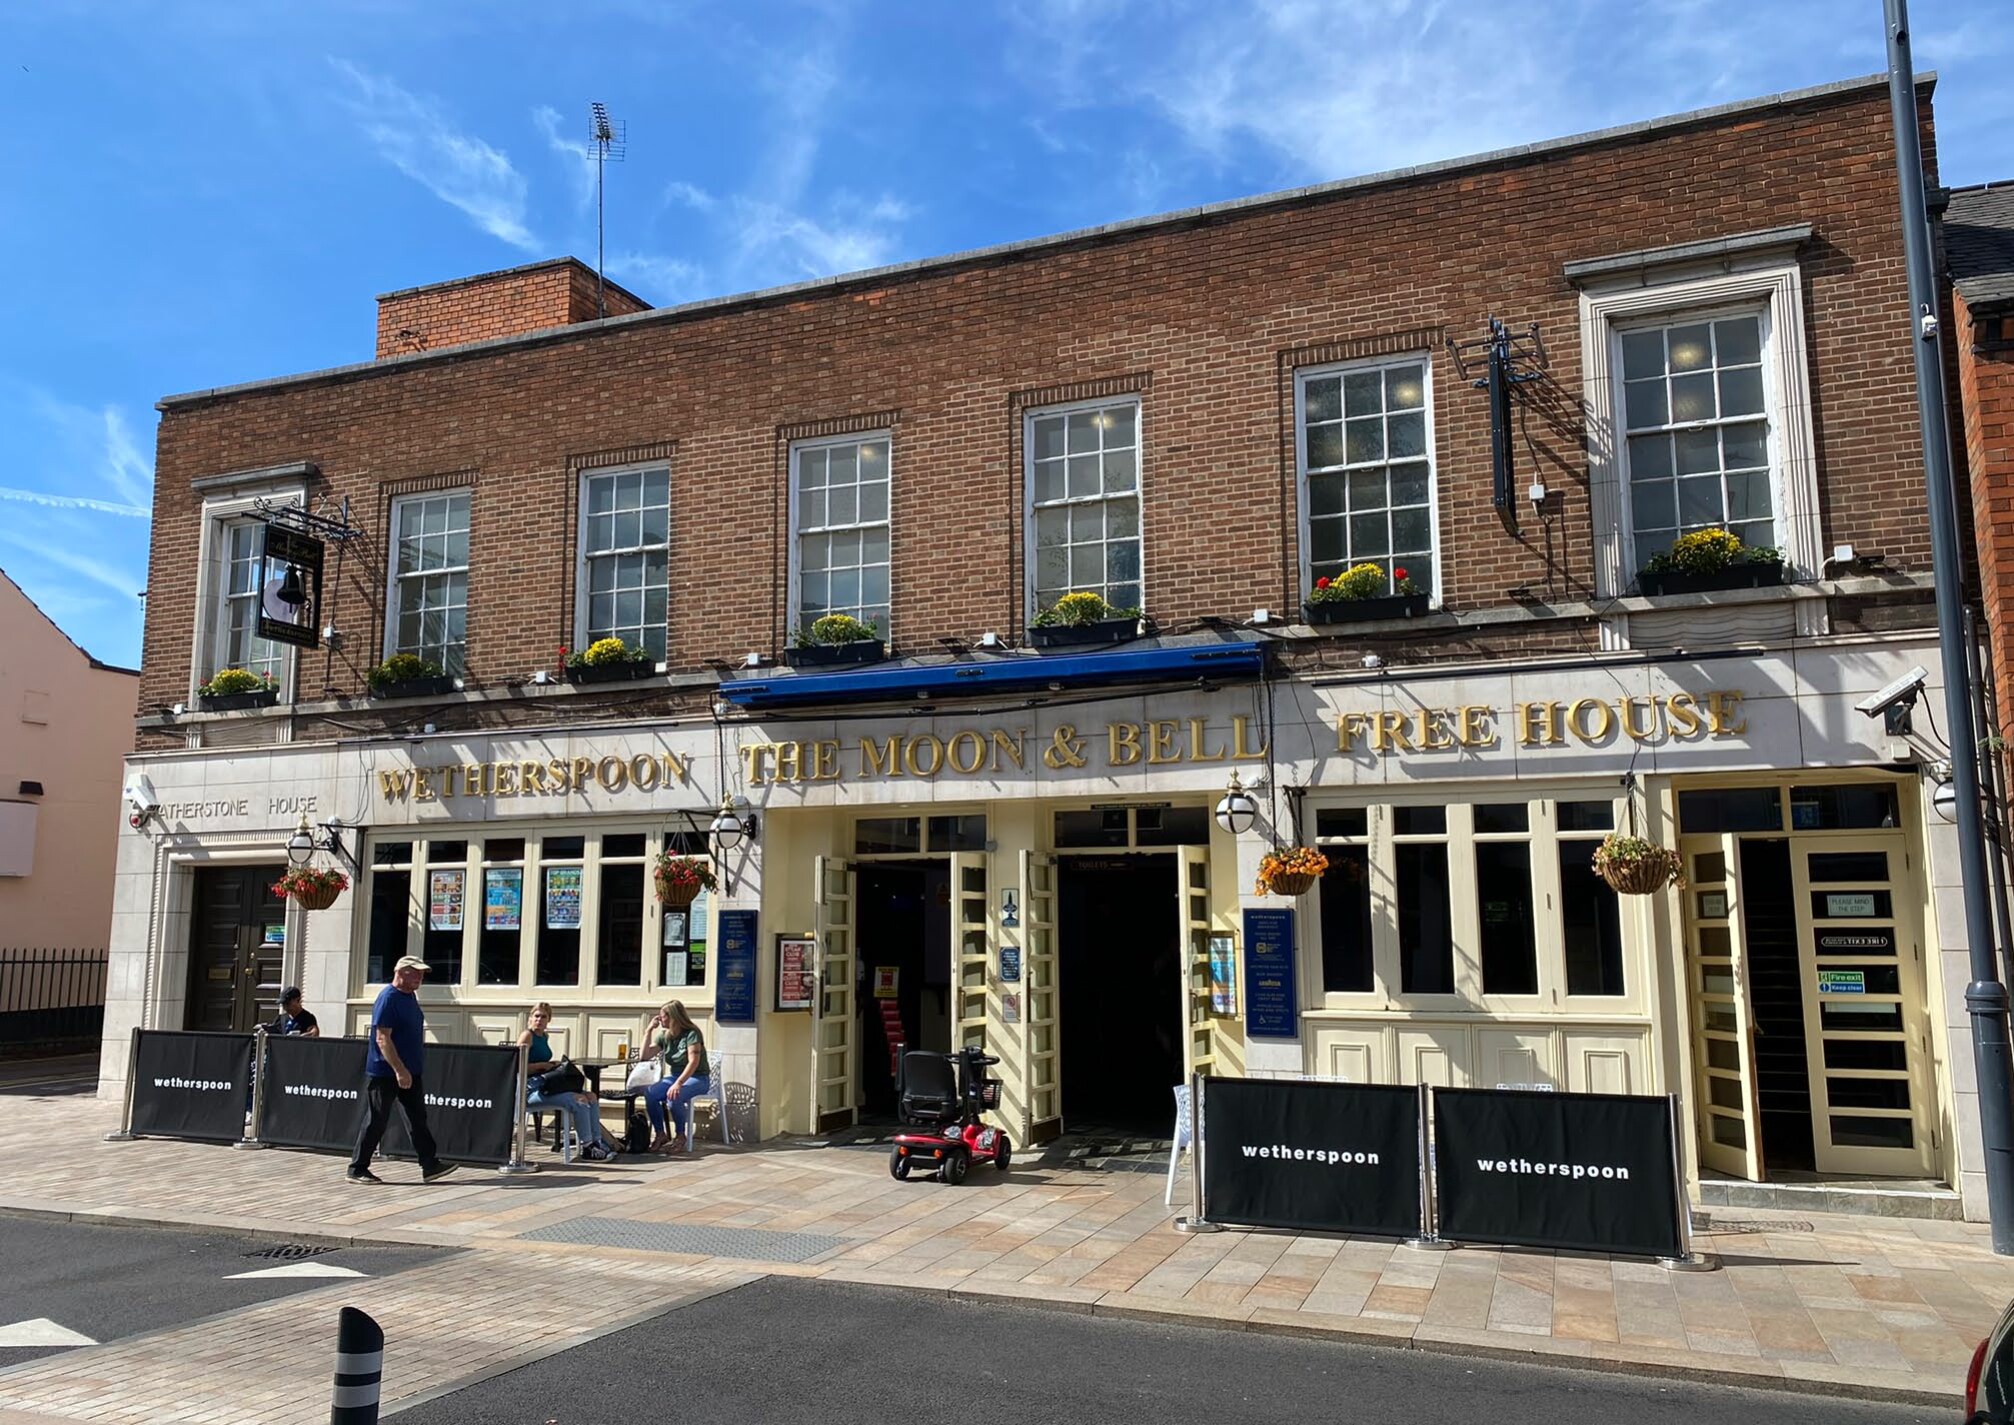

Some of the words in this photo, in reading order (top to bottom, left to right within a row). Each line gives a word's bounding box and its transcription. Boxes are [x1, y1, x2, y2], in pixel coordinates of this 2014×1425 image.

[1333, 704, 1498, 753] FREE
[1516, 690, 1748, 744] HOUSE
[740, 739, 842, 785] THE
[857, 727, 1026, 778] MOON
[1043, 723, 1088, 770] &
[1106, 715, 1269, 767] BELL
[378, 751, 687, 799] WETHERSPOON
[268, 796, 317, 815] HOUSE
[1831, 973, 1846, 981] Fire
[1847, 973, 1861, 981] exit
[1848, 983, 1862, 991] clear
[154, 1076, 232, 1091] wetherspoon
[284, 1084, 358, 1100] wetherspoon
[424, 1093, 492, 1109] therspoon
[1242, 1143, 1380, 1165] wetherspoon
[1477, 1157, 1630, 1180] wetherspoon
